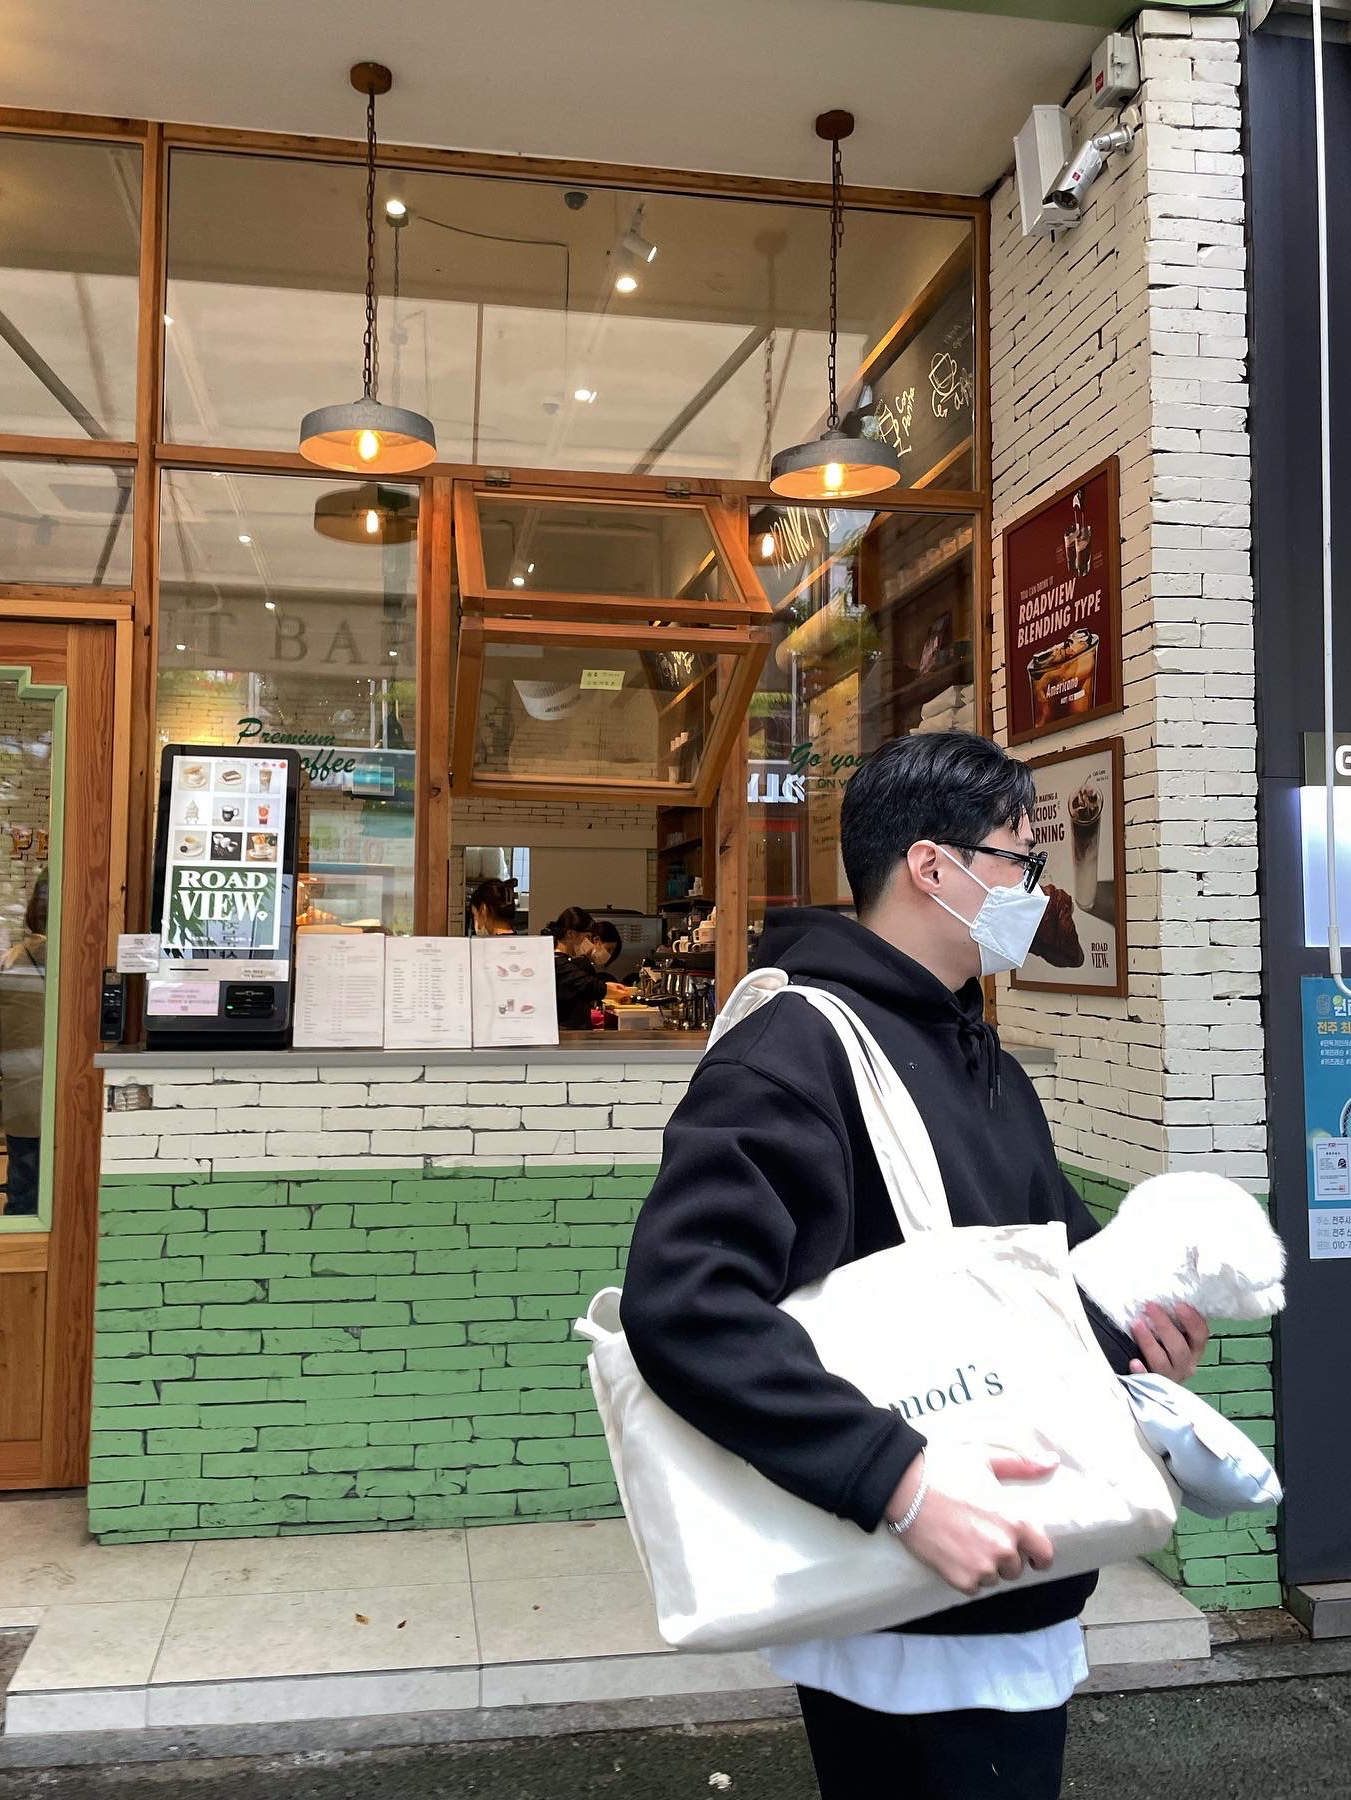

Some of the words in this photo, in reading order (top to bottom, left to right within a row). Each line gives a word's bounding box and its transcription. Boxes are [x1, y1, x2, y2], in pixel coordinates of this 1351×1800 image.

[1019, 577, 1077, 625] ROADVIEW
[1017, 605, 1071, 649] BLENDING
[1074, 589, 1102, 622] TYPE
[237, 717, 337, 745] Premium
[299, 749, 356, 782] offee
[790, 742, 821, 775] Go
[1032, 804, 1058, 823] ICIOUS
[1031, 822, 1066, 844] RNING
[178, 870, 269, 889] ROAD
[1091, 942, 1109, 951] ROAD
[1333, 996, 1351, 1017] 원
[1317, 1021, 1338, 1035] 전주
